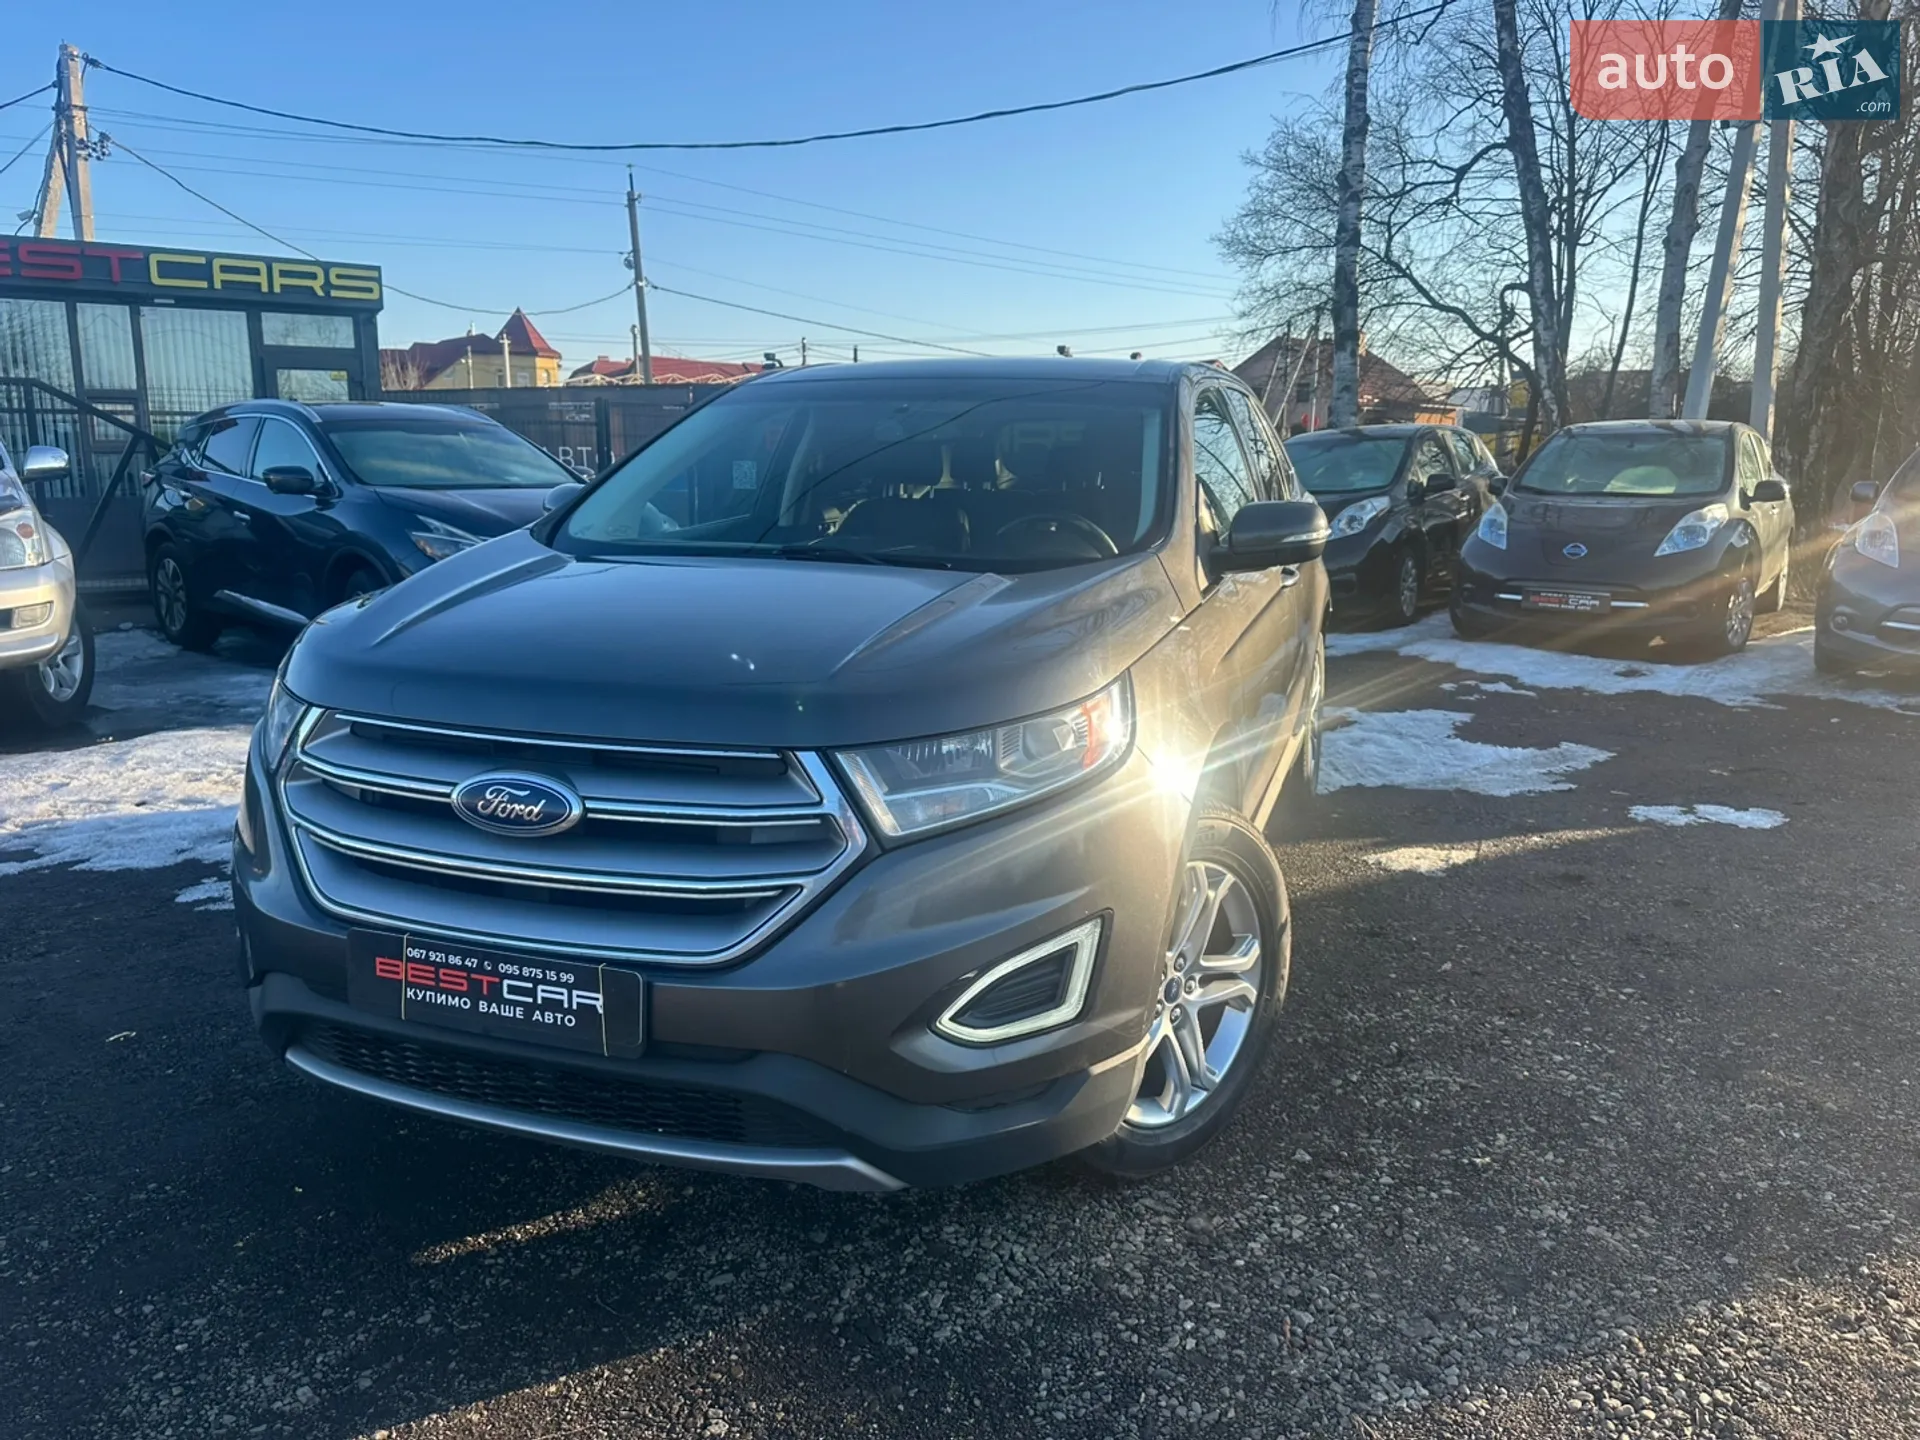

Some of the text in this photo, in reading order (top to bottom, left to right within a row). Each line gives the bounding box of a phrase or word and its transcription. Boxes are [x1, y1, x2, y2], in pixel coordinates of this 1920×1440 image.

[477, 785, 546, 821] Ford
[406, 947, 575, 984] 067 921 86 47 095 875 15 99
[375, 956, 604, 1014] BESTCAR
[406, 987, 576, 1027] КУПИМО ВАШЕ АВТО
